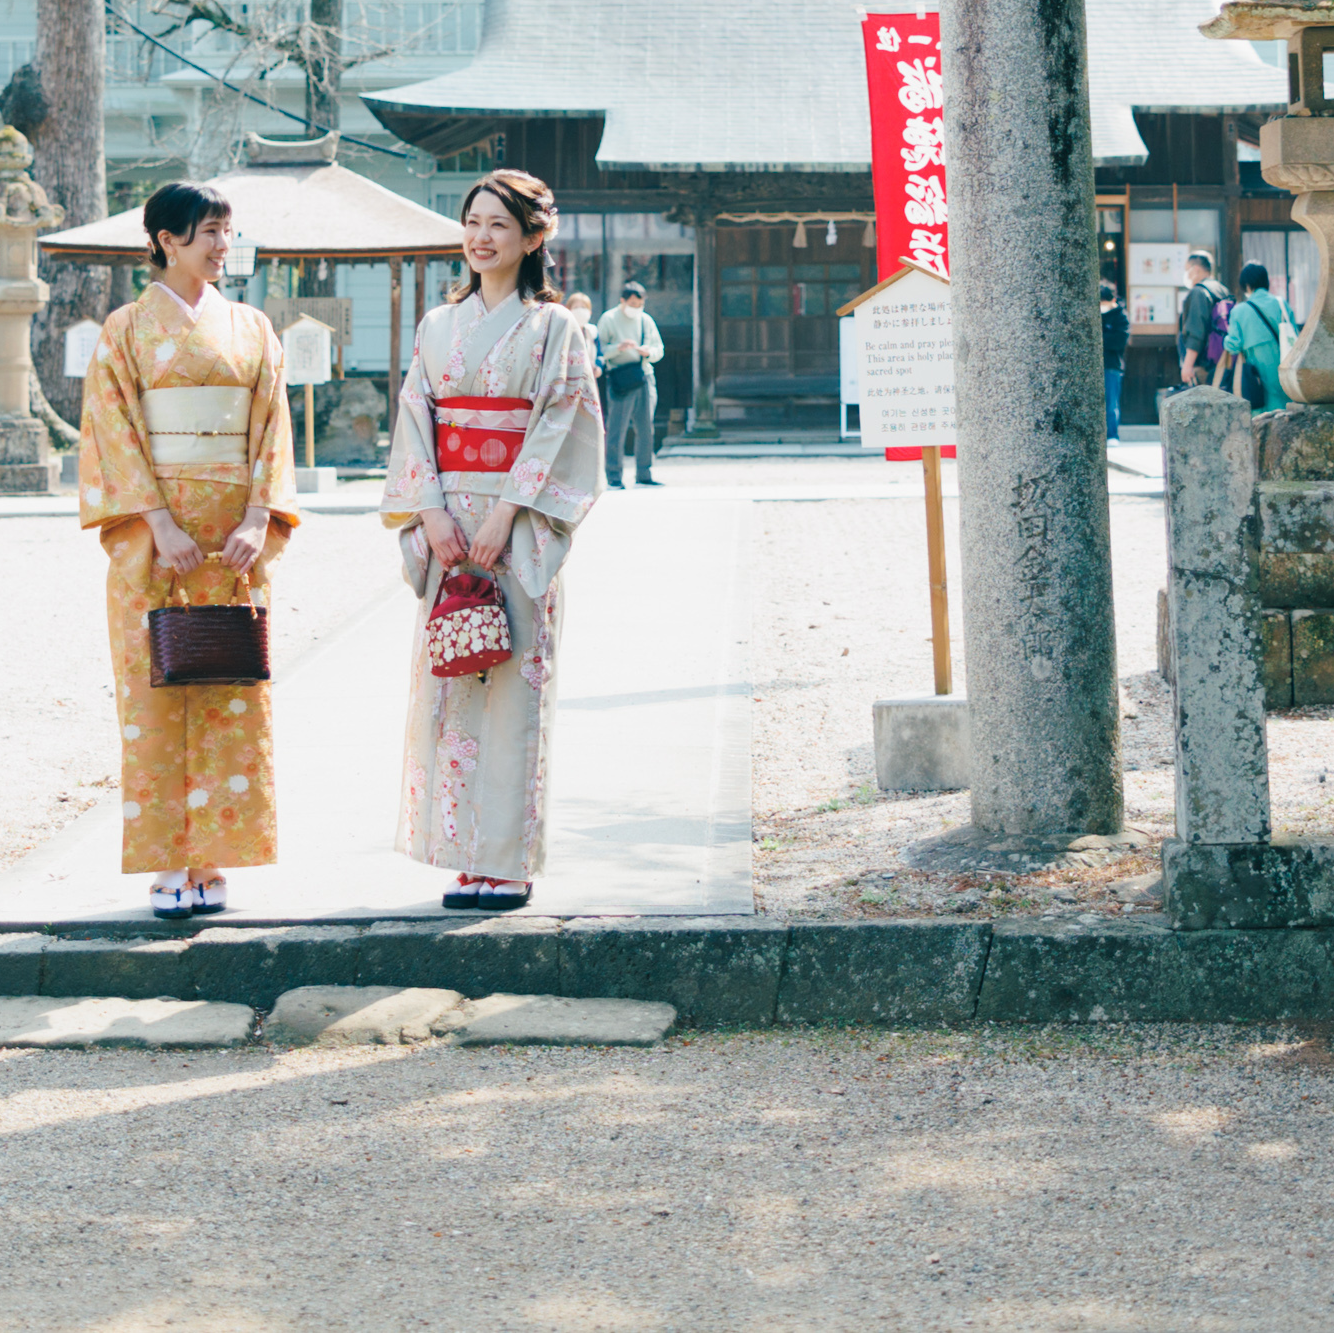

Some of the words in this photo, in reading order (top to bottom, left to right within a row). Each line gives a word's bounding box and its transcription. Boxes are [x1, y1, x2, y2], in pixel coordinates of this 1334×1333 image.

[864, 341, 876, 351] Be
[877, 340, 897, 350] calm
[899, 339, 914, 349] and
[916, 340, 936, 350] pray
[867, 353, 885, 363] This
[886, 354, 906, 362] area
[907, 352, 916, 361] is
[916, 351, 934, 362] holy
[866, 366, 893, 376] sacred
[895, 367, 913, 377] spot
[911, 407, 937, 417] 신성한
